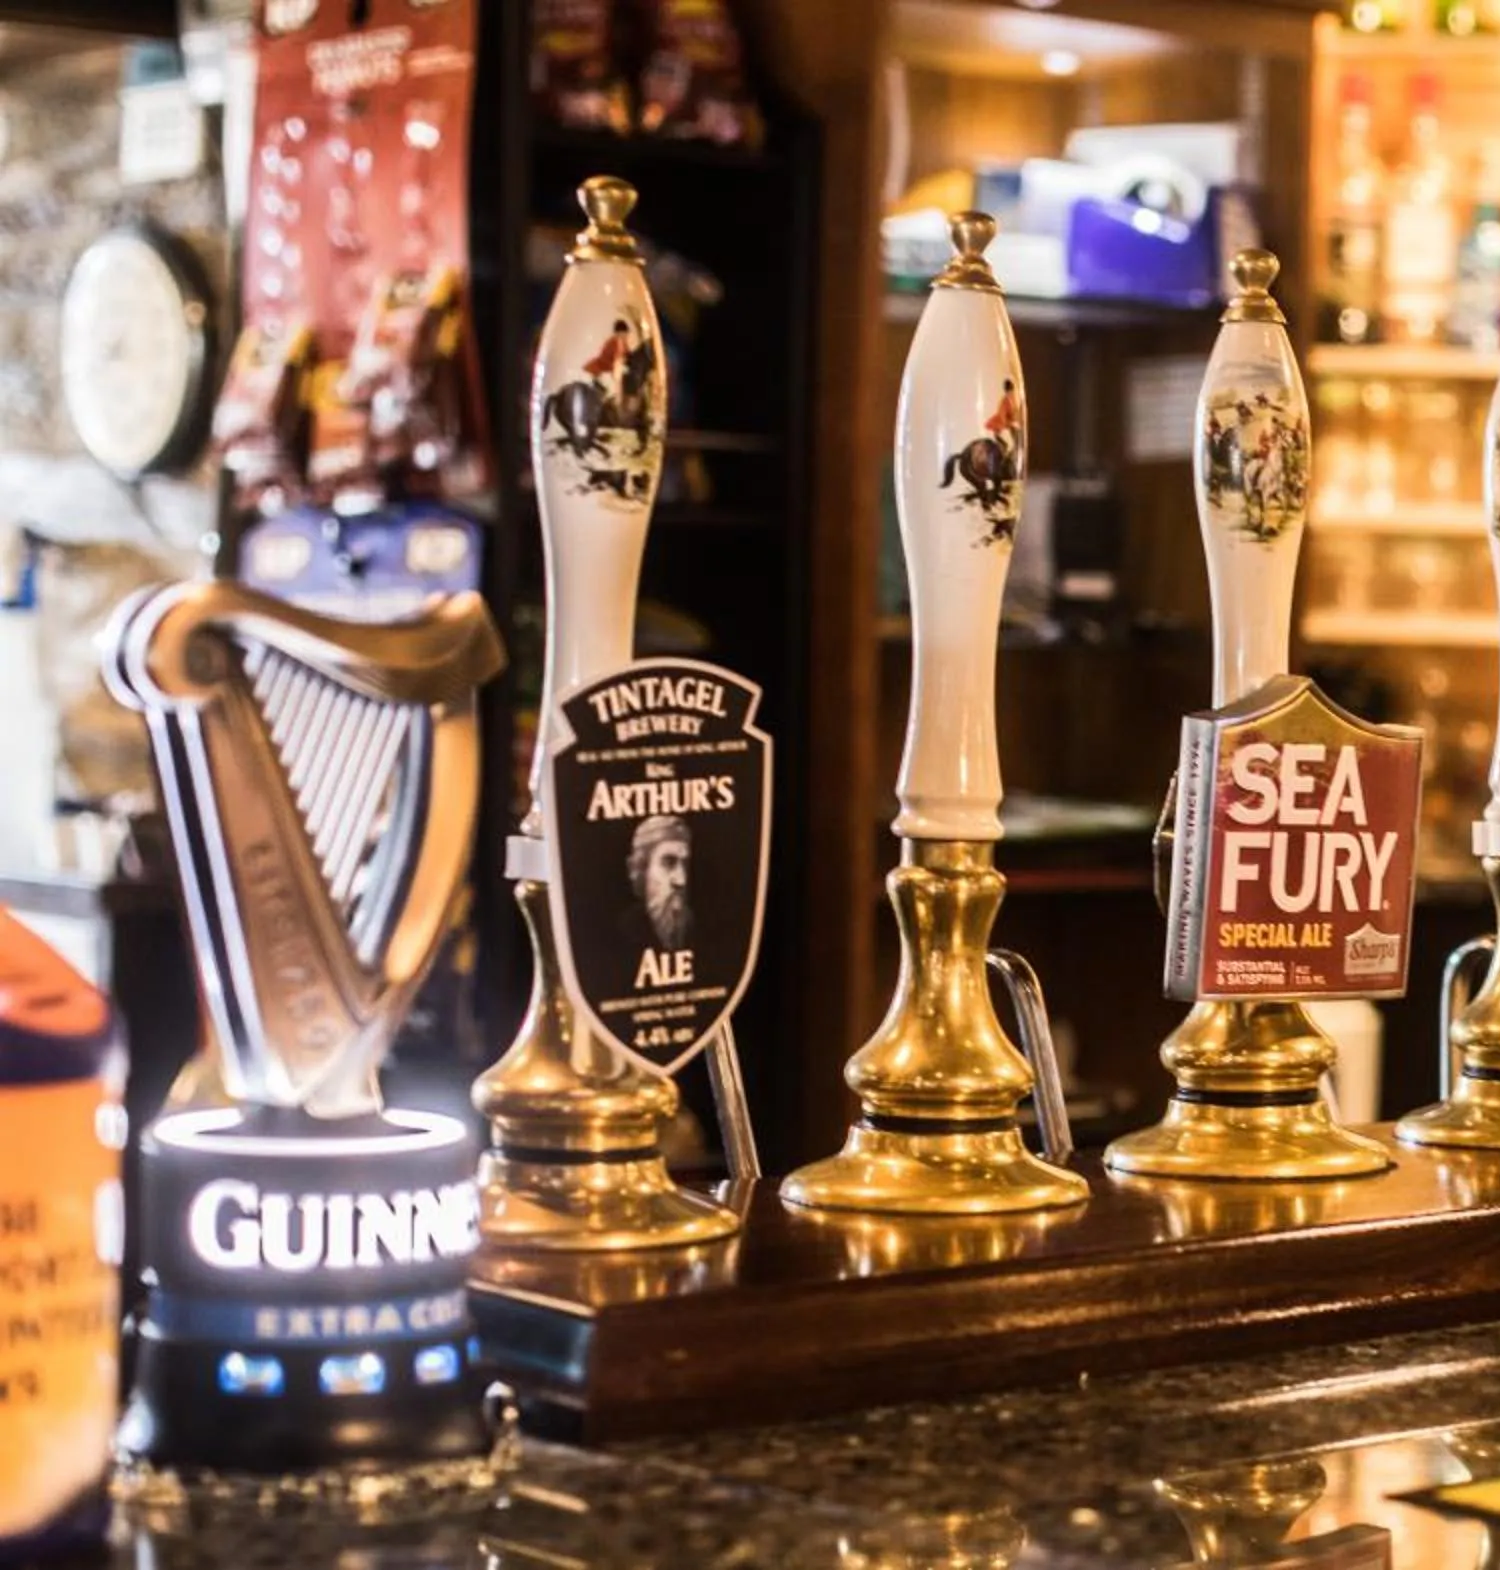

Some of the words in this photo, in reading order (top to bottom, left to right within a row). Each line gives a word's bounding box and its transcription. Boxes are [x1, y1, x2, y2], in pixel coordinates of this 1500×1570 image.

[588, 677, 727, 723] TINTAGEL
[615, 713, 704, 742] BREWERY
[587, 775, 736, 822] ARTHUR'S
[1225, 742, 1368, 826] SEA
[1218, 922, 1297, 948] SPECIAL
[1300, 922, 1334, 948] ALE
[634, 947, 695, 989] ALE
[1215, 959, 1286, 974] SUBSTANTIAL
[1227, 973, 1286, 986] SATISFYING
[189, 1178, 481, 1272] GUINNE
[254, 1303, 404, 1339] EXTRA
